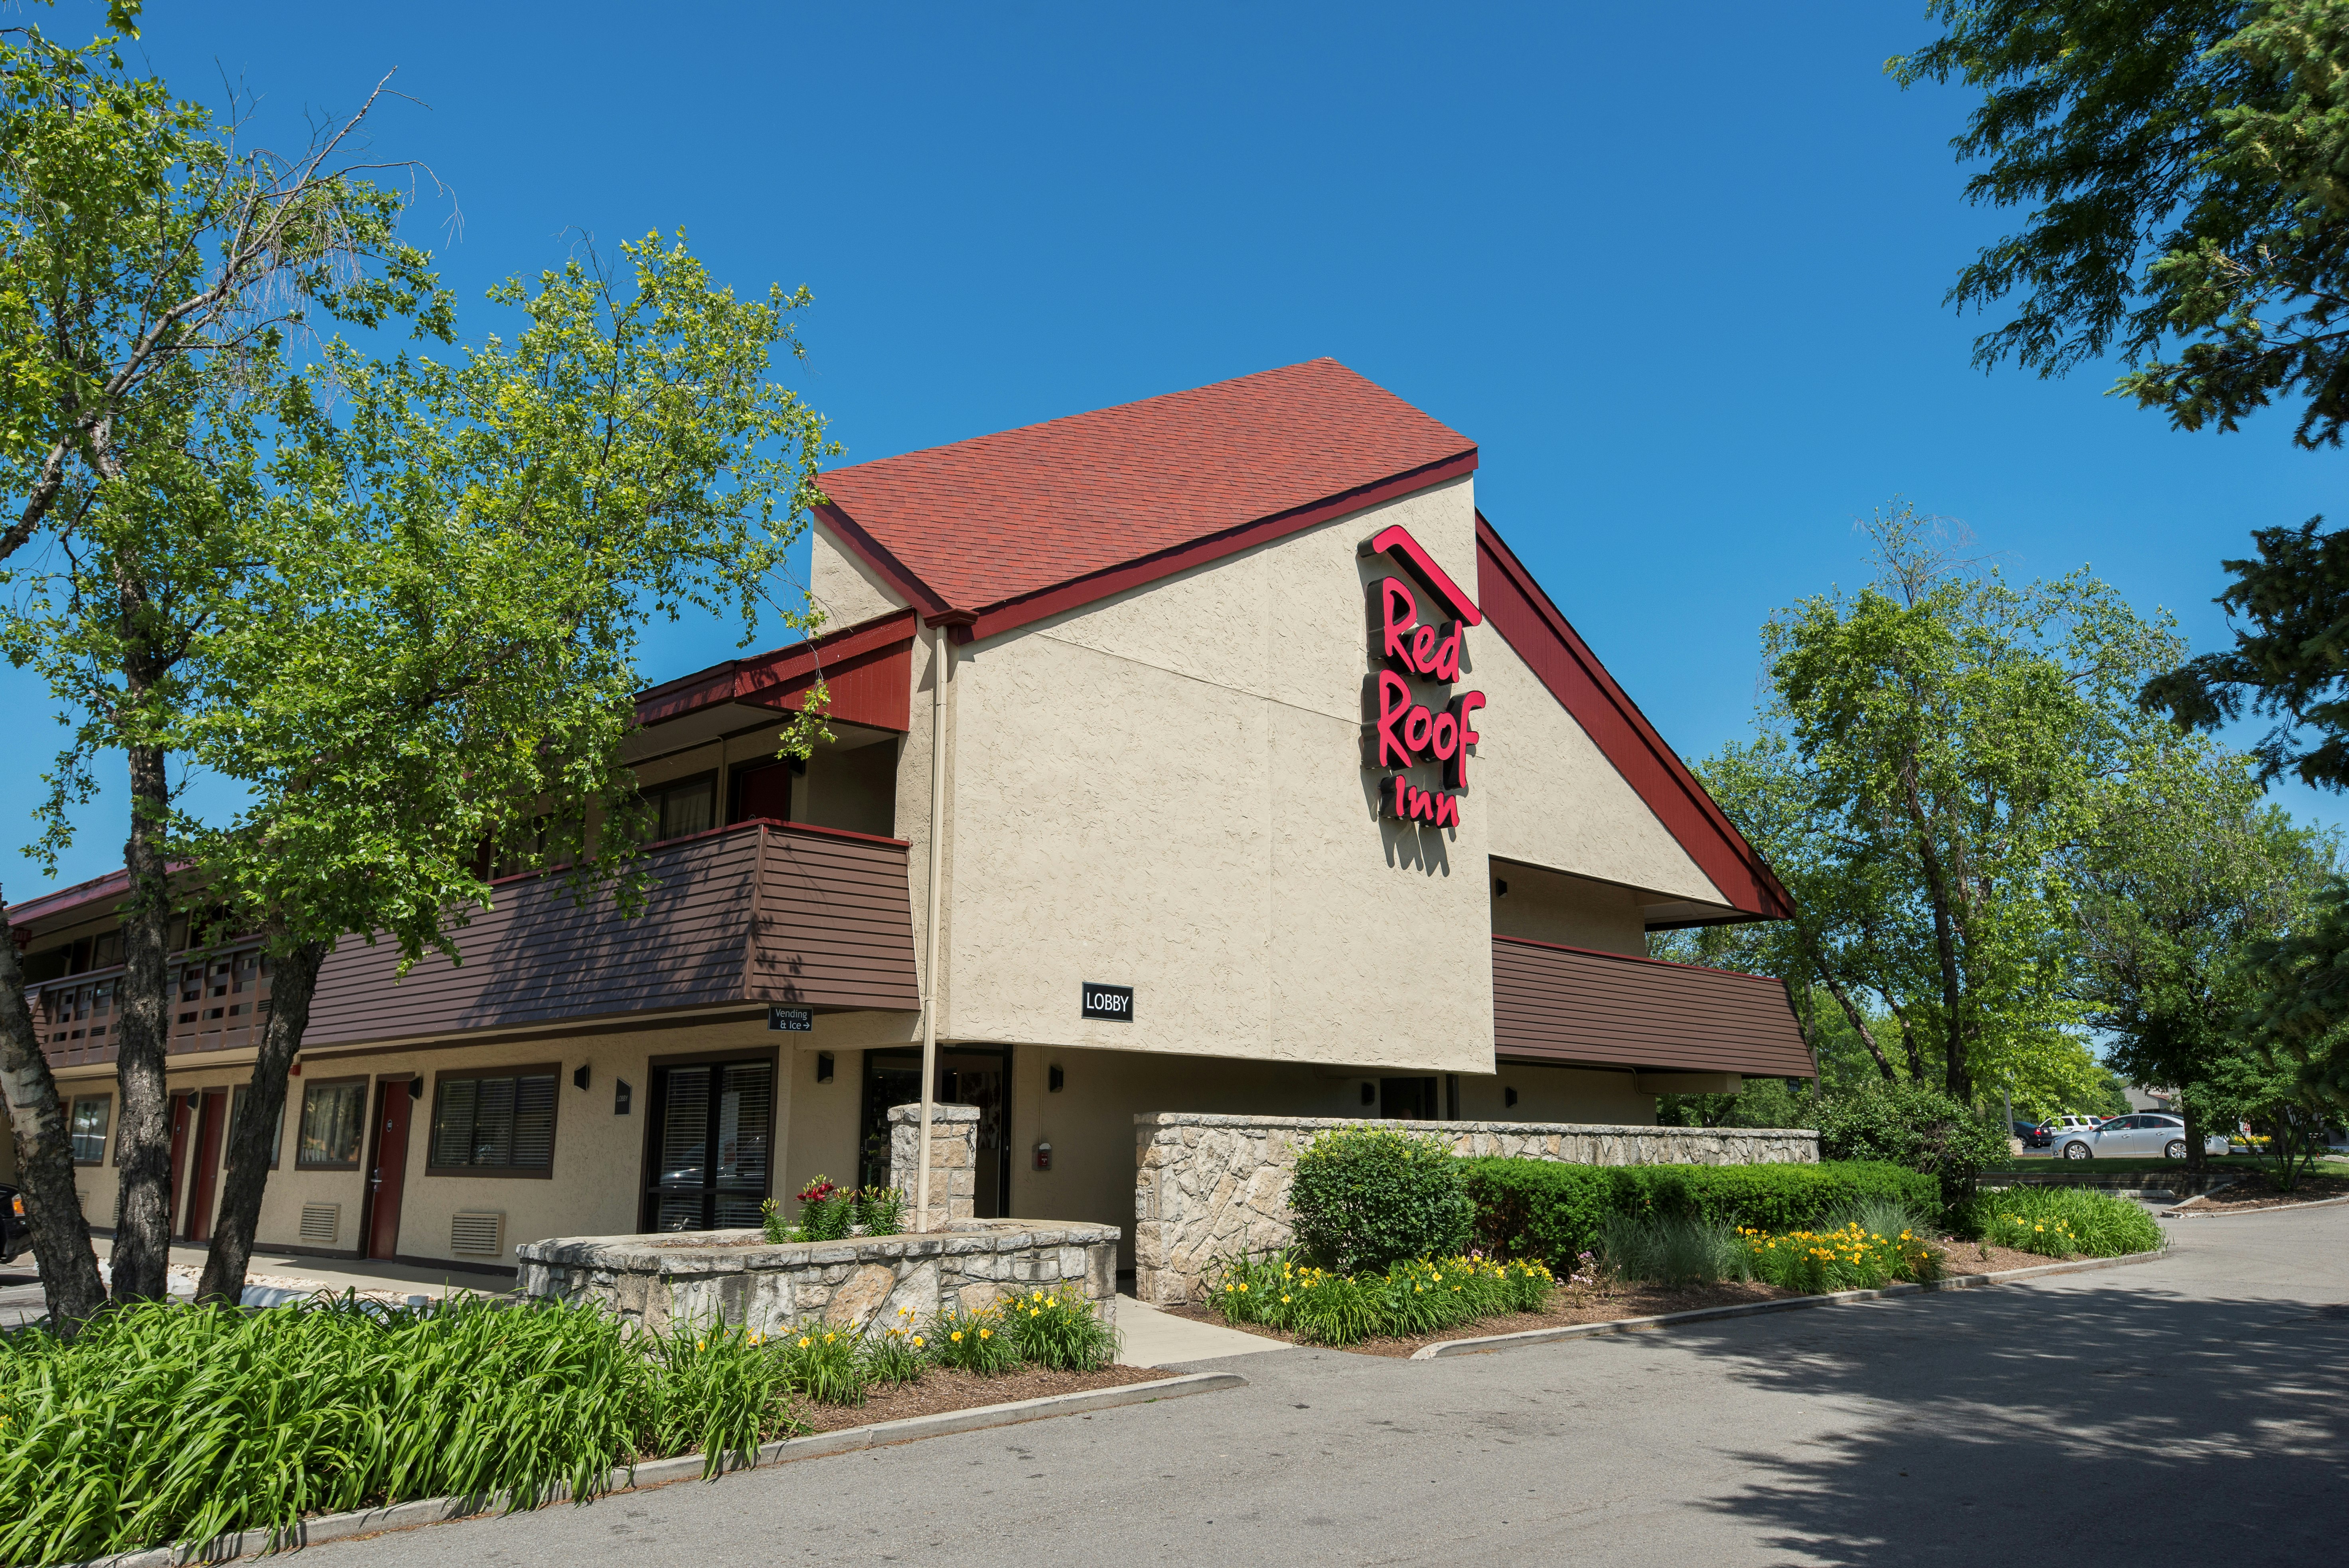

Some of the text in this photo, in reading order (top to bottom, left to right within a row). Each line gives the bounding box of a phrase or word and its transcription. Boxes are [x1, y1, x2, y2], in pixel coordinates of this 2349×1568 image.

[1383, 576, 1462, 683] Red
[1378, 669, 1486, 788] Roof
[1396, 774, 1460, 827] Inn
[776, 1008, 807, 1020] Vending
[1087, 992, 1129, 1012] LOBBY
[780, 1020, 801, 1029] & Ice
